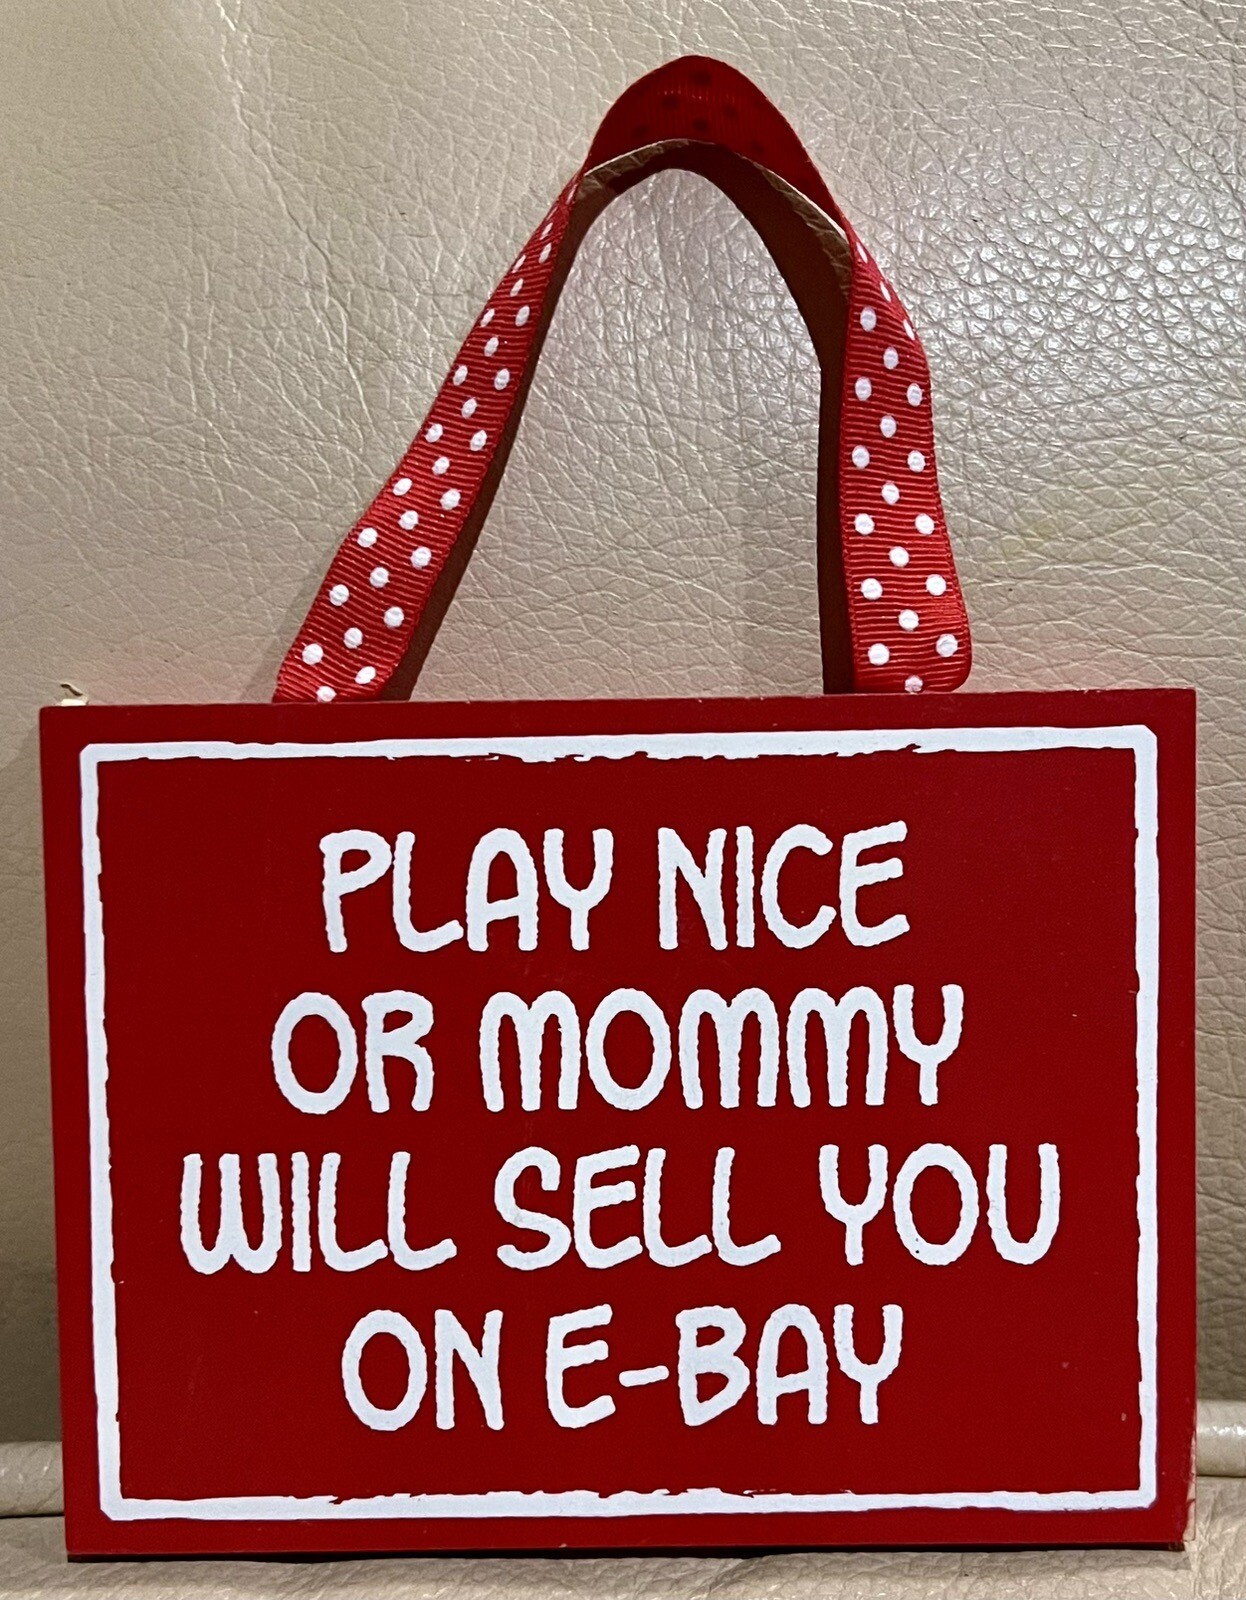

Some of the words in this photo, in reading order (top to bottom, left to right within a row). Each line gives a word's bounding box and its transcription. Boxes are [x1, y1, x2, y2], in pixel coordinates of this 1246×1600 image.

[319, 827, 613, 953] PLAY
[657, 821, 910, 951] NICE
[271, 990, 435, 1114] OR
[479, 984, 964, 1112] MOMMY
[180, 1151, 457, 1275] WILL
[495, 1145, 781, 1270] SELL
[819, 1142, 1061, 1266] YOU
[342, 1309, 505, 1431] ON
[546, 1303, 904, 1428] E-BAY
